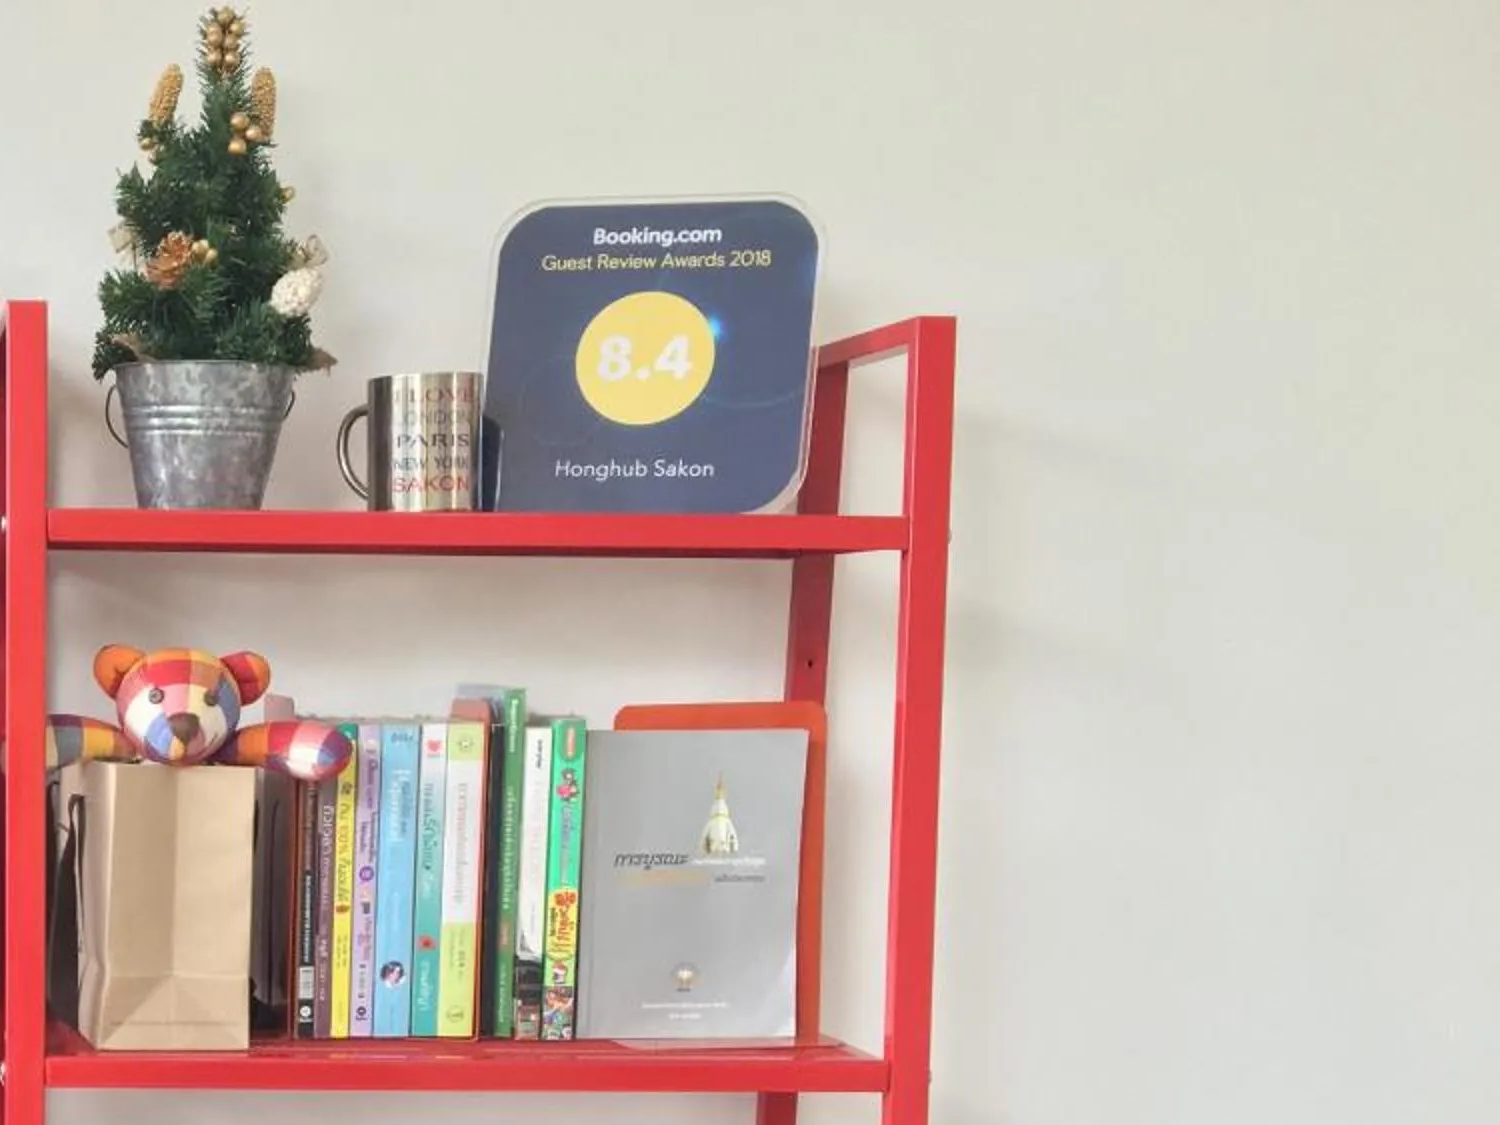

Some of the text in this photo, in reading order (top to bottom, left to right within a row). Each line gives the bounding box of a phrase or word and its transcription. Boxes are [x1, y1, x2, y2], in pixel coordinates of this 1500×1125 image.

[593, 227, 722, 247] Booking.com
[542, 250, 772, 271] Guest Review Awards 2018
[597, 335, 692, 381] 8.4
[396, 433, 470, 448] PARIS
[555, 459, 714, 482] Honghub Sakon
[392, 475, 469, 493] SAKON
